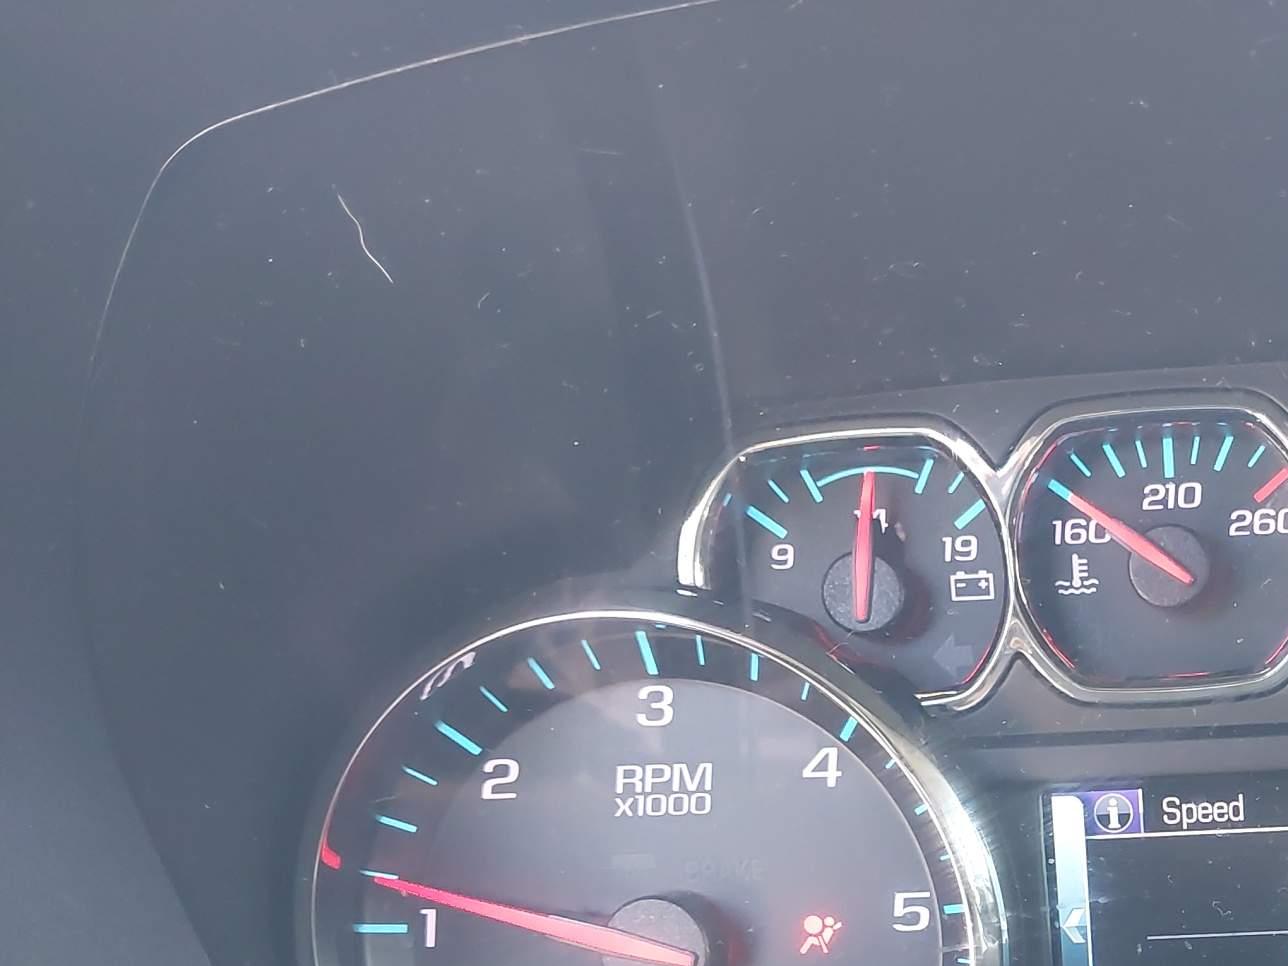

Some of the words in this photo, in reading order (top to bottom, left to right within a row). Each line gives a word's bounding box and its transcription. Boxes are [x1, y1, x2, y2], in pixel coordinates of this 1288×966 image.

[1143, 482, 1201, 510] 210
[1052, 518, 1111, 545] 160
[771, 544, 793, 569] 9
[942, 536, 977, 561] 19
[636, 686, 673, 726] 3
[482, 759, 519, 799] 2
[616, 763, 713, 794] RPM
[803, 748, 841, 787] 4
[614, 794, 712, 817] x1000
[1162, 793, 1245, 829] Speed
[893, 891, 932, 931] 5
[420, 909, 436, 947] 1
